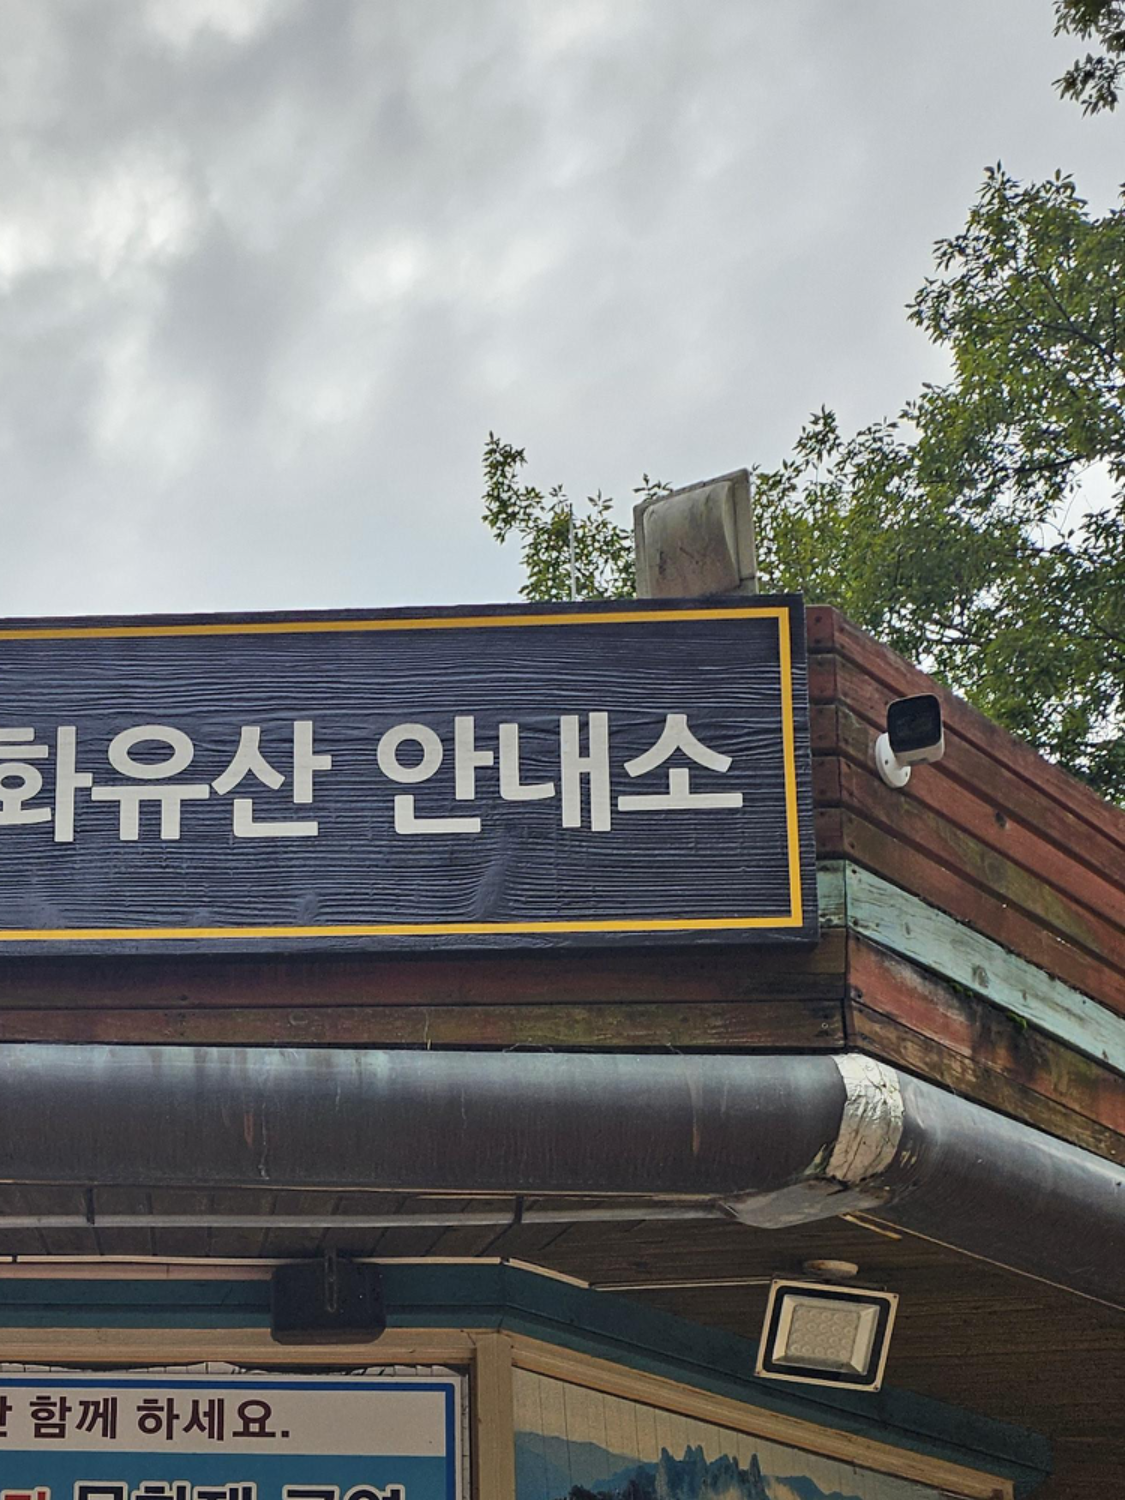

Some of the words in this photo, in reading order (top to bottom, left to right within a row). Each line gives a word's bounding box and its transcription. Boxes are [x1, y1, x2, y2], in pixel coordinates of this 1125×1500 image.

[377, 711, 744, 834] 안내소
[30, 1396, 118, 1440] 함께
[137, 1397, 292, 1441] 하세요.
